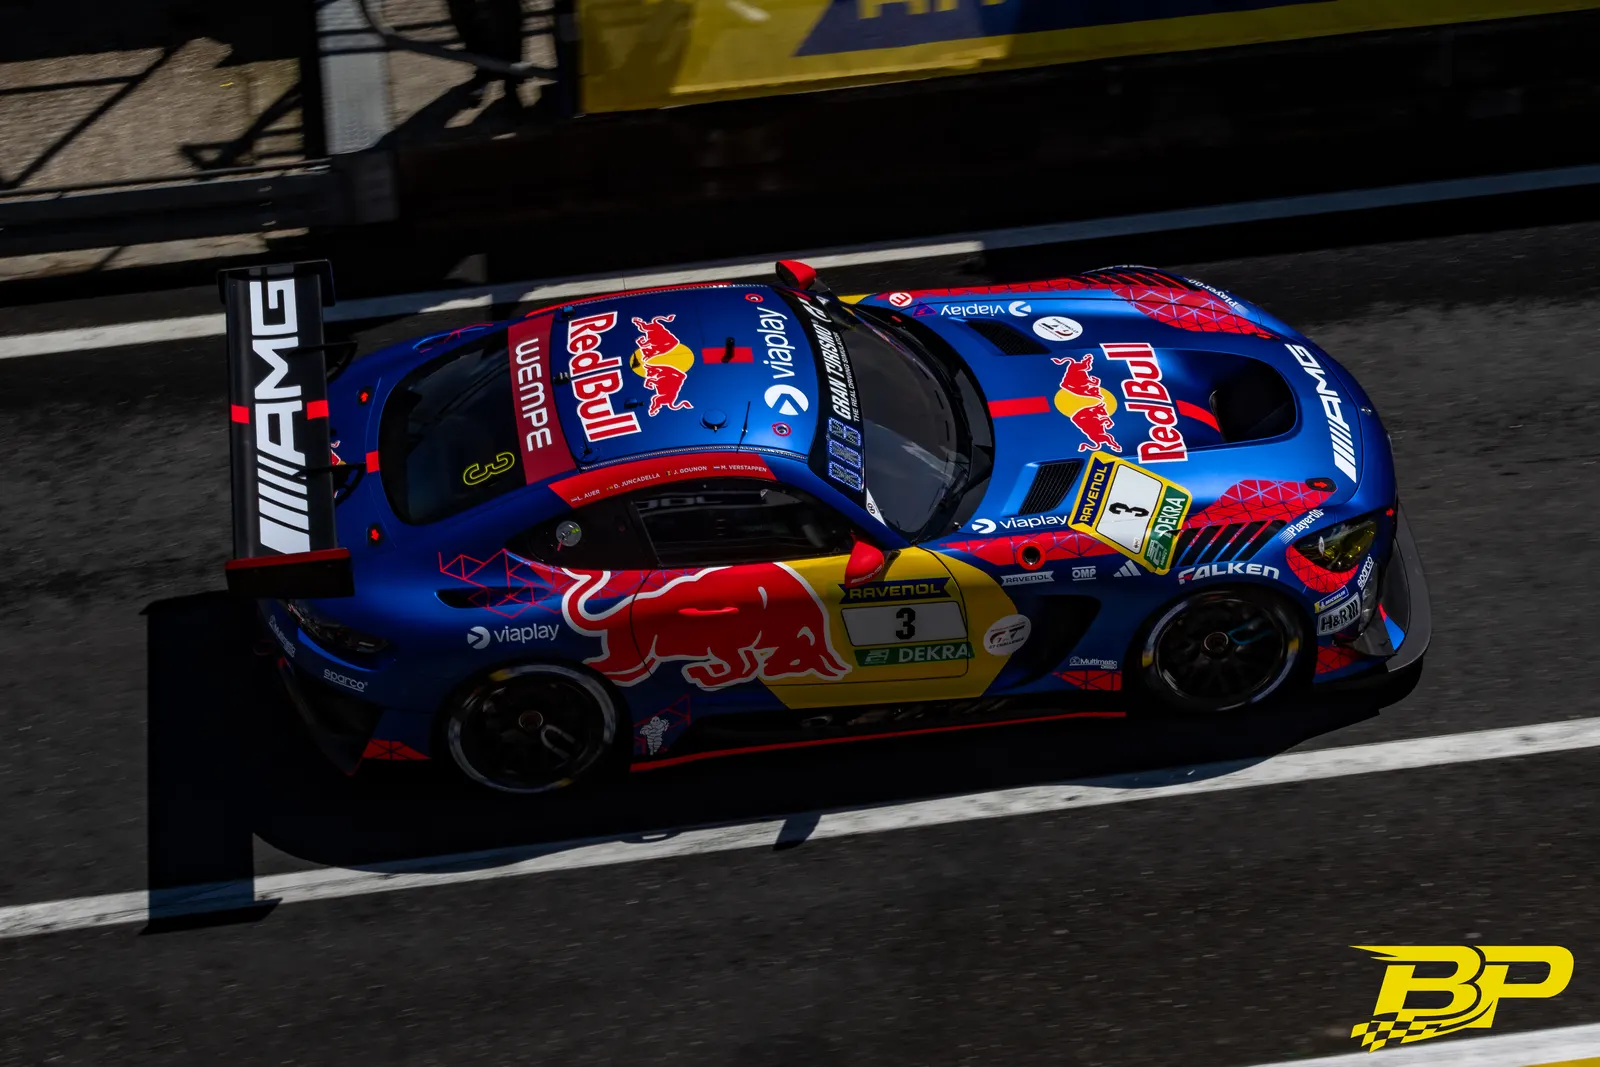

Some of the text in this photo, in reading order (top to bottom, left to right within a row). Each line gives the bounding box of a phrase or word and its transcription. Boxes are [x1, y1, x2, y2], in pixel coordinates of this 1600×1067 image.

[940, 304, 1006, 318] viaplay
[756, 306, 796, 379] viaplay
[249, 277, 306, 476] AMG
[515, 338, 552, 452] WEMPE
[828, 375, 852, 420] GRAN
[849, 389, 858, 407] REAL
[1284, 344, 1352, 438] AMG
[853, 406, 861, 422] THE
[463, 452, 515, 486] 3
[679, 465, 707, 474] GOUNON
[621, 473, 660, 488] JUNCADELLA
[584, 489, 601, 500] AUER
[1078, 466, 1108, 522] RAVENOL
[1108, 502, 1150, 518] 3
[1153, 497, 1187, 539] DEKRA
[1000, 515, 1068, 529] viaplay
[1005, 574, 1050, 584] RAVENOL
[1072, 569, 1097, 579] OMP
[1178, 563, 1280, 585] FALKEN
[1357, 556, 1375, 590] sparco
[849, 583, 941, 599] RAVENOL
[493, 623, 560, 644] viaplay
[895, 607, 916, 640] 3
[898, 643, 971, 663] DEKRA
[323, 669, 366, 692] sparco
